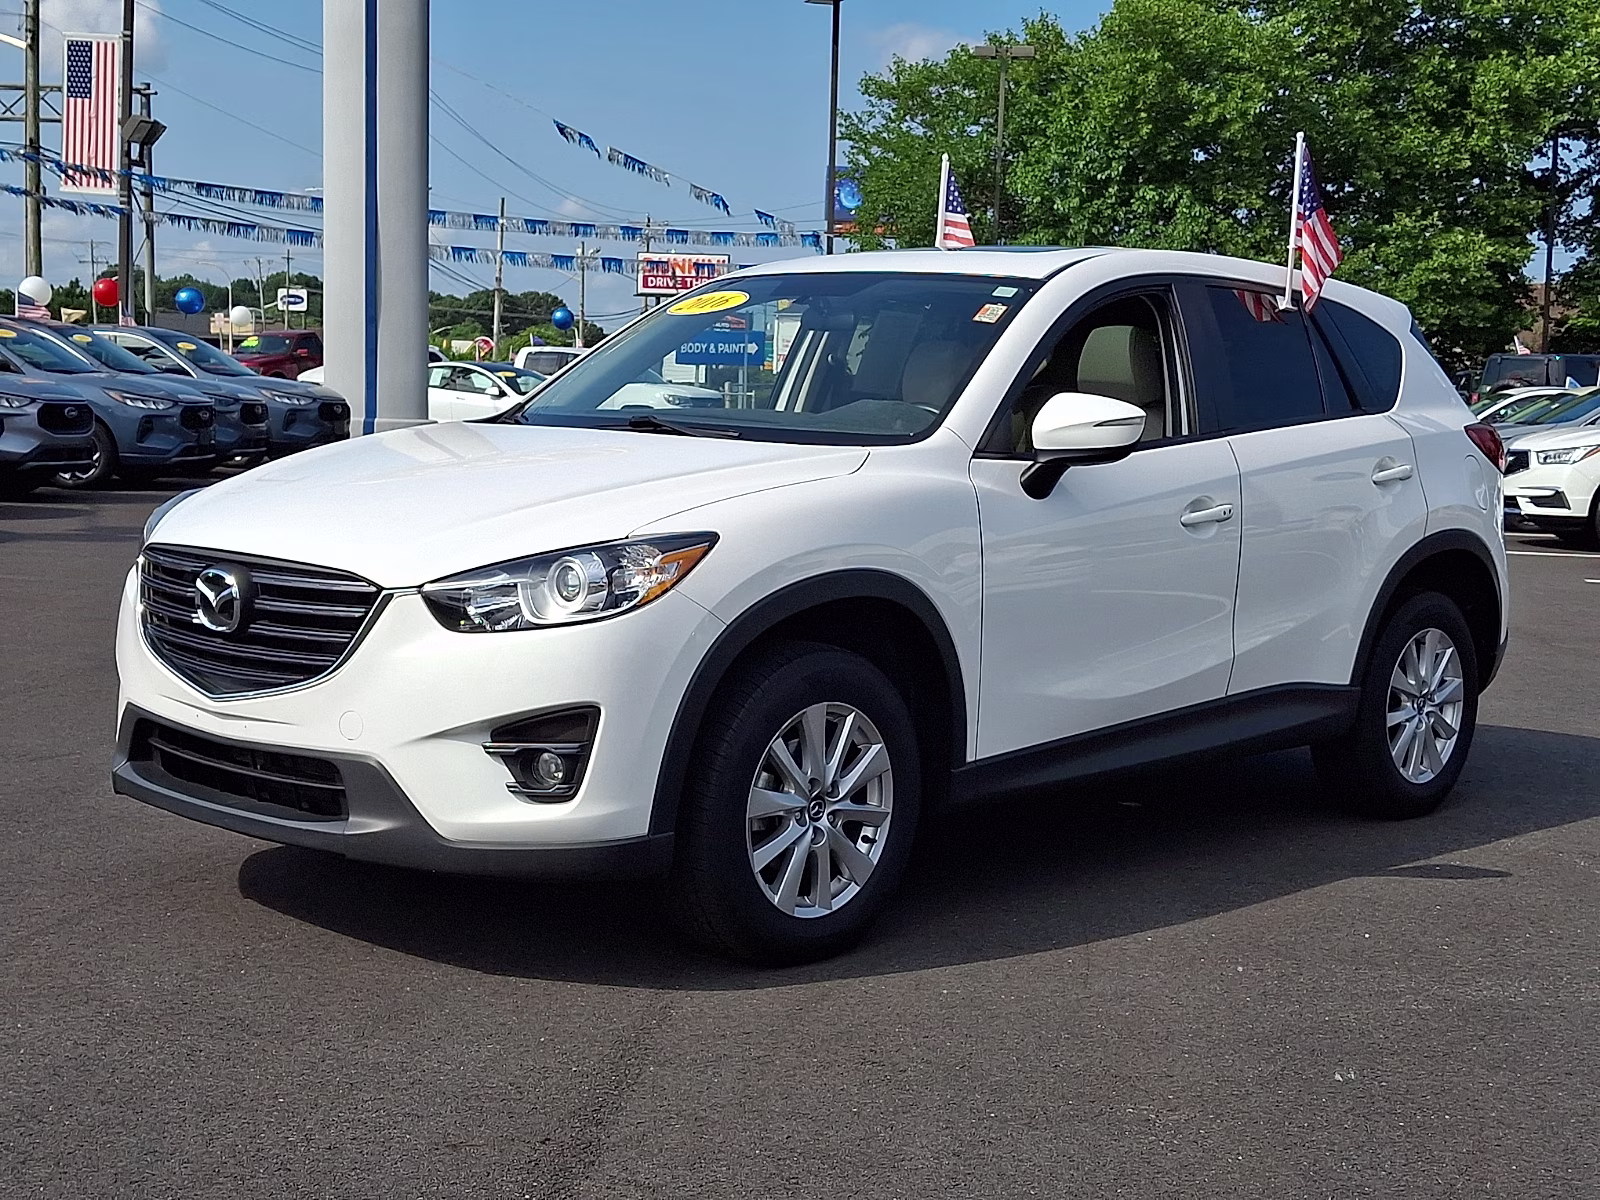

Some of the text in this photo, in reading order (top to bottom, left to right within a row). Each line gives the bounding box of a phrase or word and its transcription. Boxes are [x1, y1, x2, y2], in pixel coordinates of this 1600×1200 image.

[647, 276, 683, 287] DRIVE
[680, 342, 746, 355] BODY & PAINT
